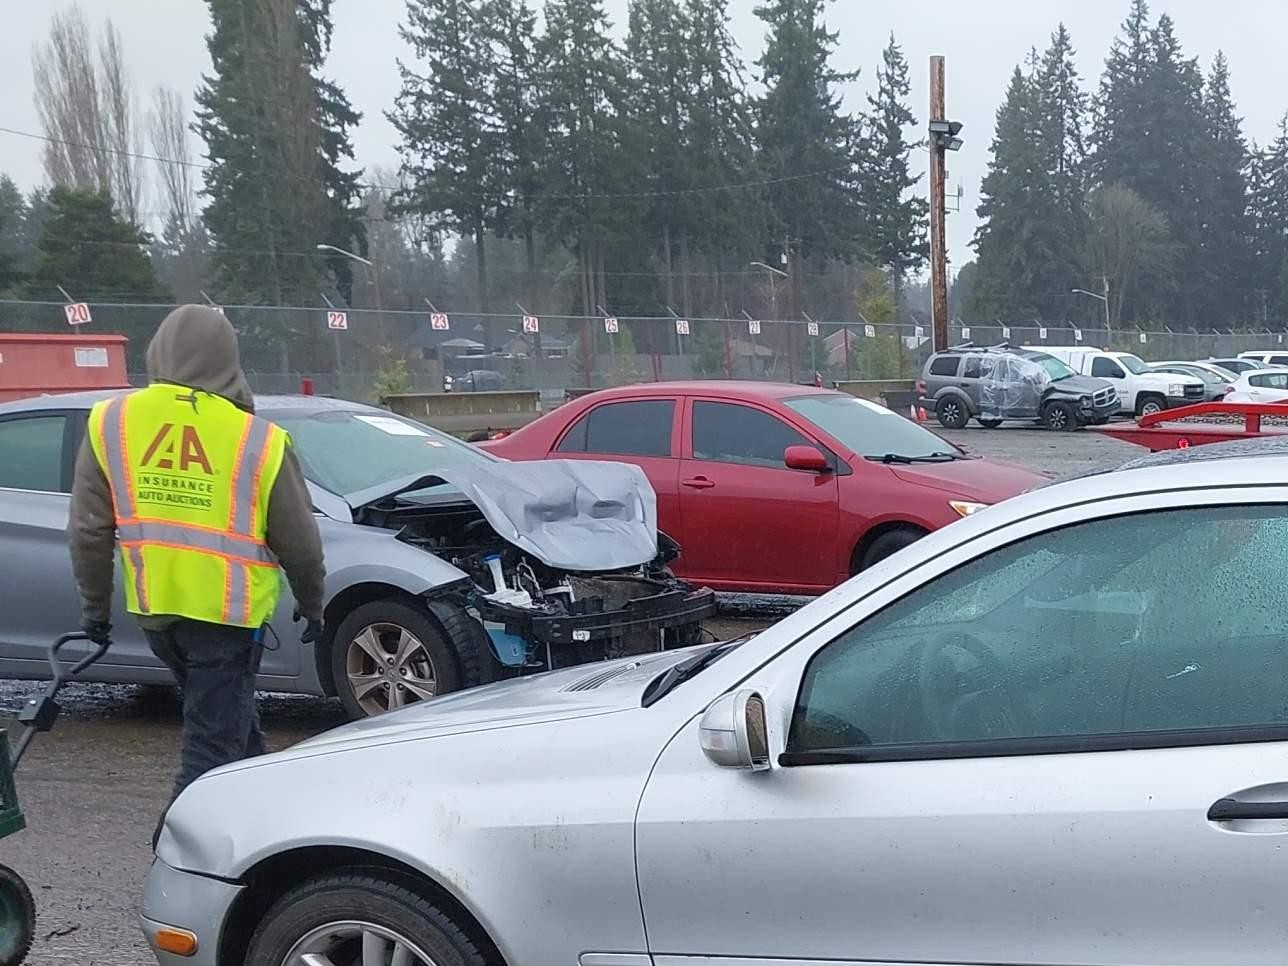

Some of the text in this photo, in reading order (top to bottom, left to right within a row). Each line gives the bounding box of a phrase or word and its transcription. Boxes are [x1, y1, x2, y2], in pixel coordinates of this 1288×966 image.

[67, 305, 88, 322] 20
[329, 313, 345, 328] 22
[432, 314, 447, 329] 23
[525, 316, 538, 331] 24
[606, 319, 617, 332] 25
[677, 320, 688, 333] 26
[138, 476, 214, 493] INSURANCE
[138, 491, 213, 508] AUTO AUCTIONS
